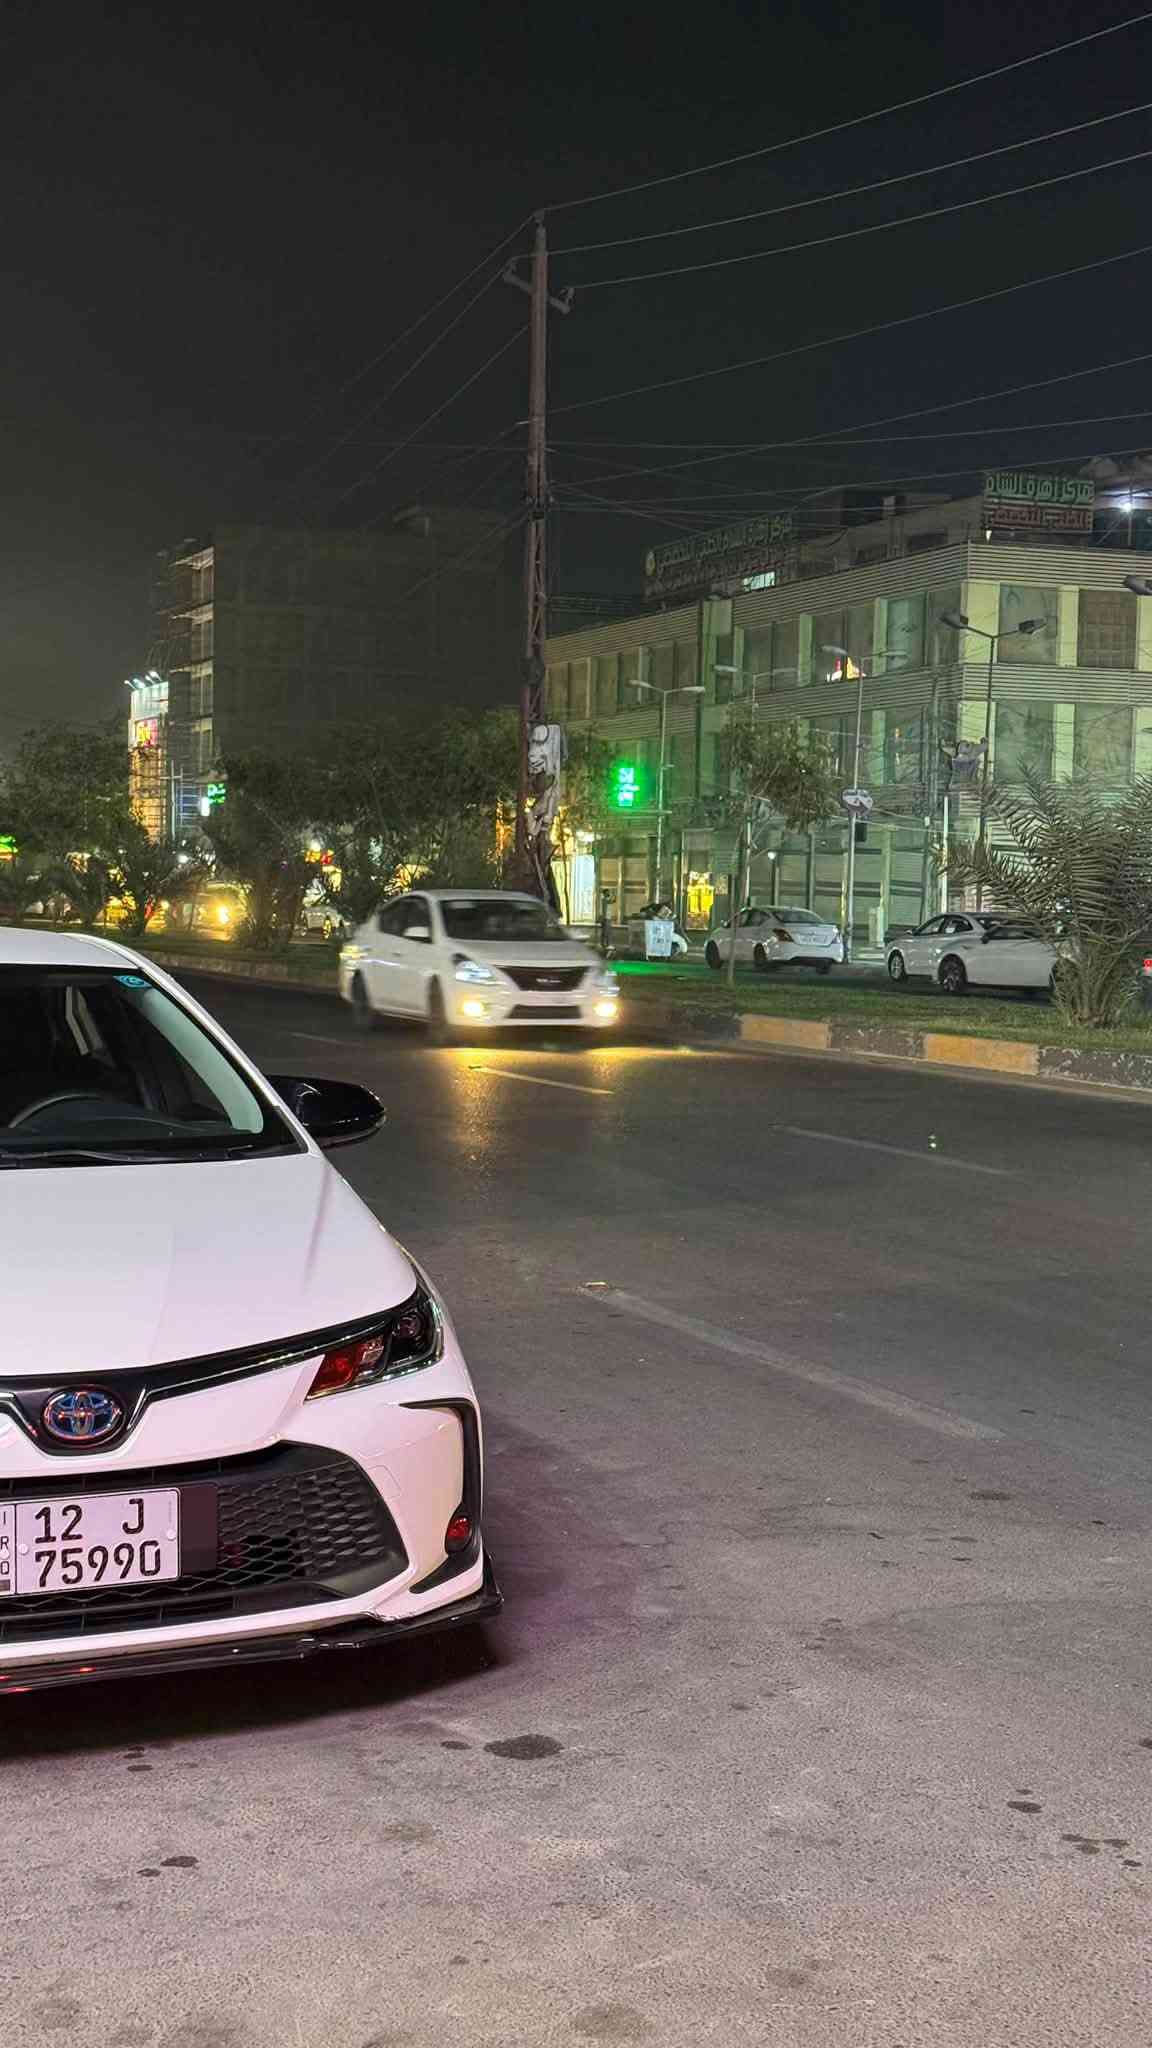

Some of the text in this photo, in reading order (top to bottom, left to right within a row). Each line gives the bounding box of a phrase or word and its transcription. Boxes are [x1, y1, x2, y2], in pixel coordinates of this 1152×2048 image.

[1026, 473, 1058, 502] زهرة
[1059, 477, 1095, 504] مركز
[34, 1503, 84, 1545] 12
[121, 1497, 145, 1535] J
[34, 1539, 162, 1588] 75990
